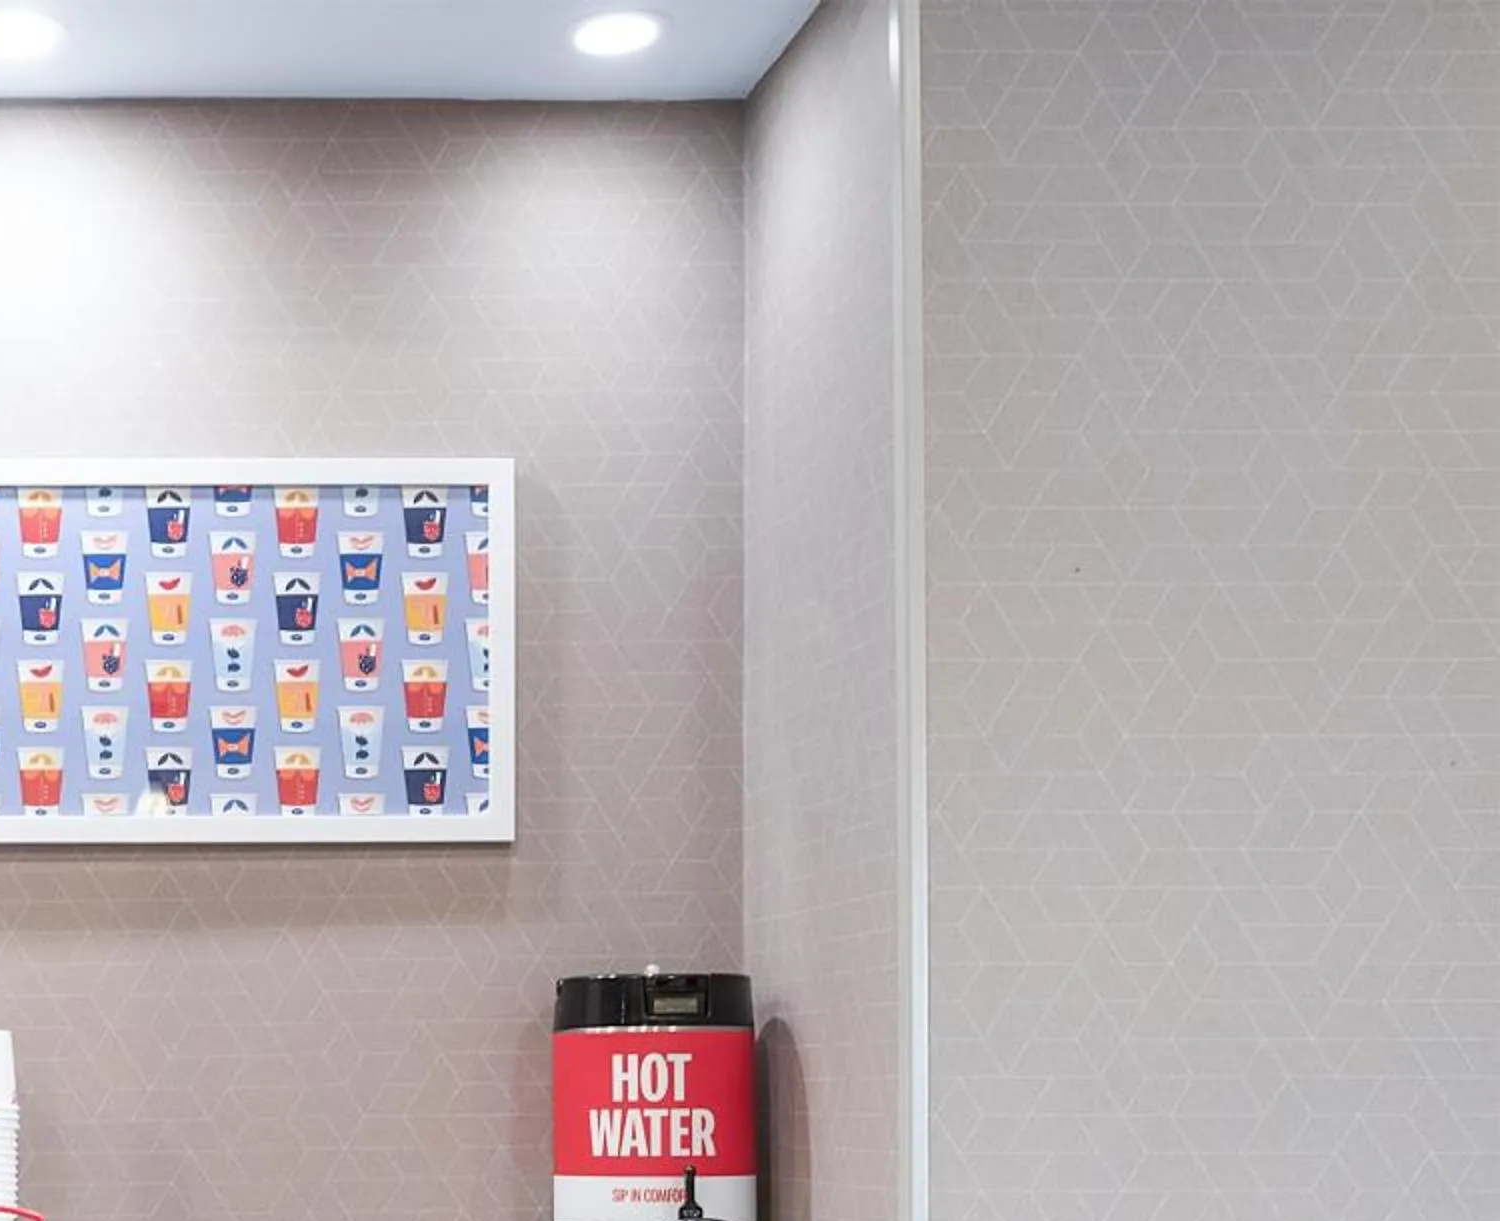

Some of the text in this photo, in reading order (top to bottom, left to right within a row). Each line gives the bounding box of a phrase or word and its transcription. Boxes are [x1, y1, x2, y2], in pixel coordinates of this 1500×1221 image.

[611, 1053, 693, 1103] HOT
[589, 1108, 717, 1157] WATER
[611, 1187, 687, 1202] SIP IN COMFOR
